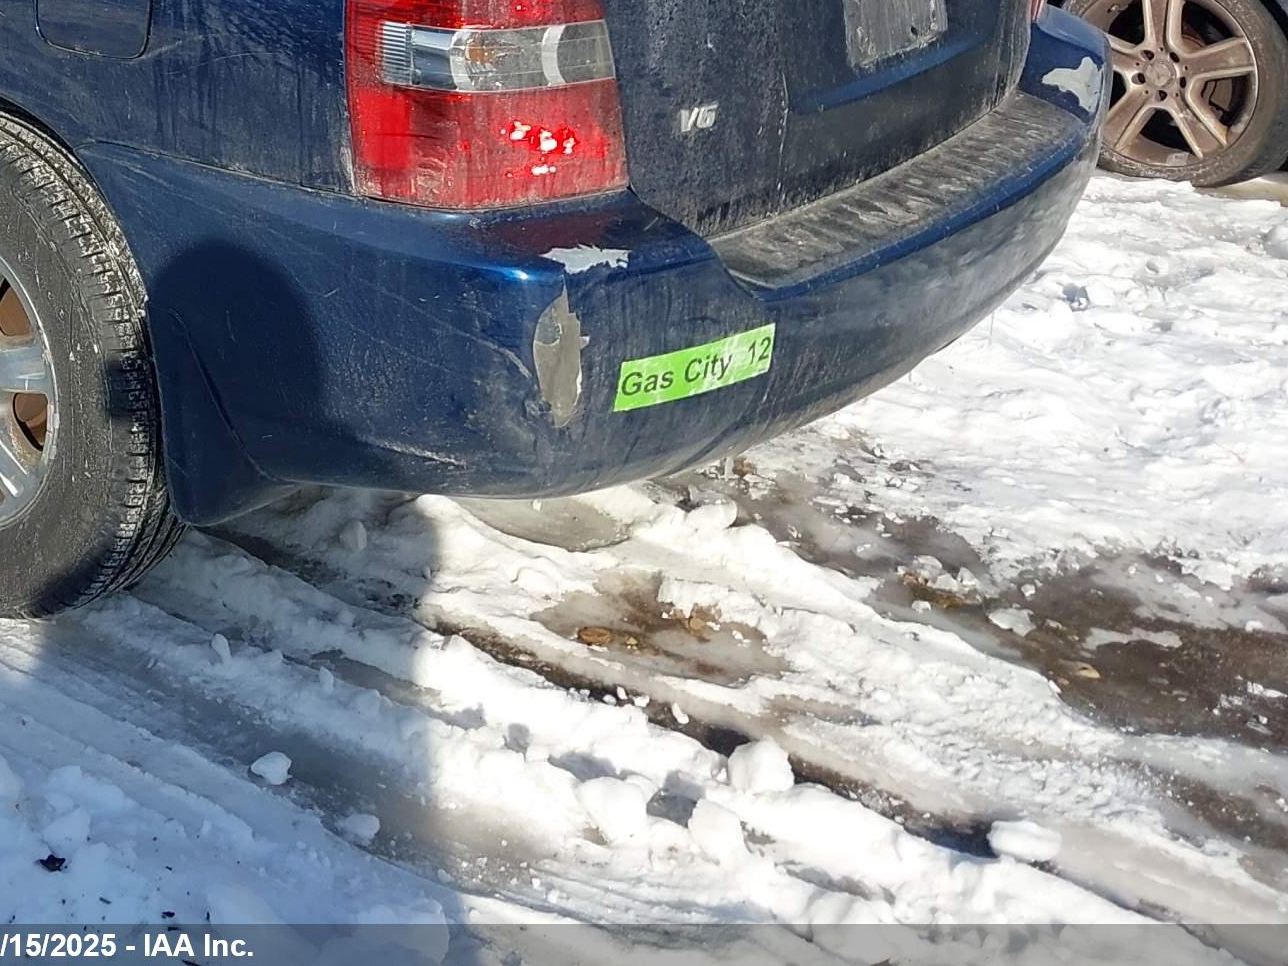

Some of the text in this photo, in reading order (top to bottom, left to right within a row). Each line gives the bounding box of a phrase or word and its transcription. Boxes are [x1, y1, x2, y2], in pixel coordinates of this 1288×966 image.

[680, 101, 719, 132] V6
[621, 336, 772, 396] Gas City 12
